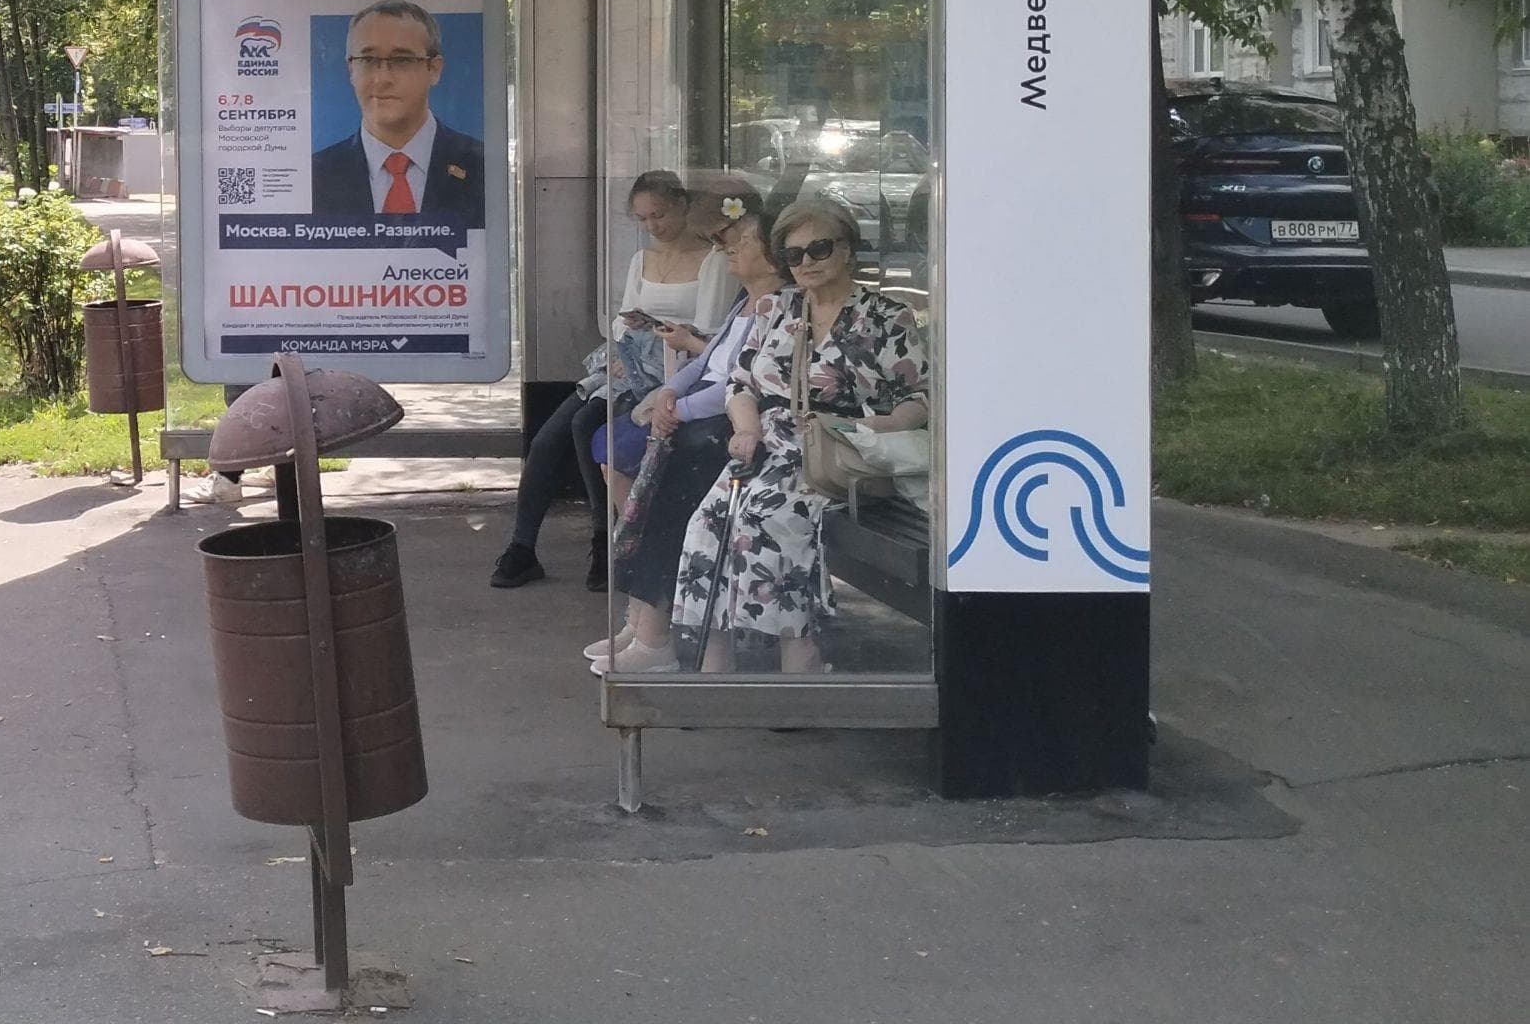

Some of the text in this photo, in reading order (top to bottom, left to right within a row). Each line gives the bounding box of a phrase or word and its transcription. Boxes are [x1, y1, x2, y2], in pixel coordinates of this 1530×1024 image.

[237, 60, 279, 68] ЕДИНАЯ
[218, 109, 297, 120] СЕНТЯБРЯ
[225, 223, 455, 241] Москва. Будущее. Развитие.
[382, 263, 469, 281] Алексей
[229, 283, 468, 308] ШАПОШНИКОВ
[281, 340, 389, 352] КОМАНДА МЭРА
